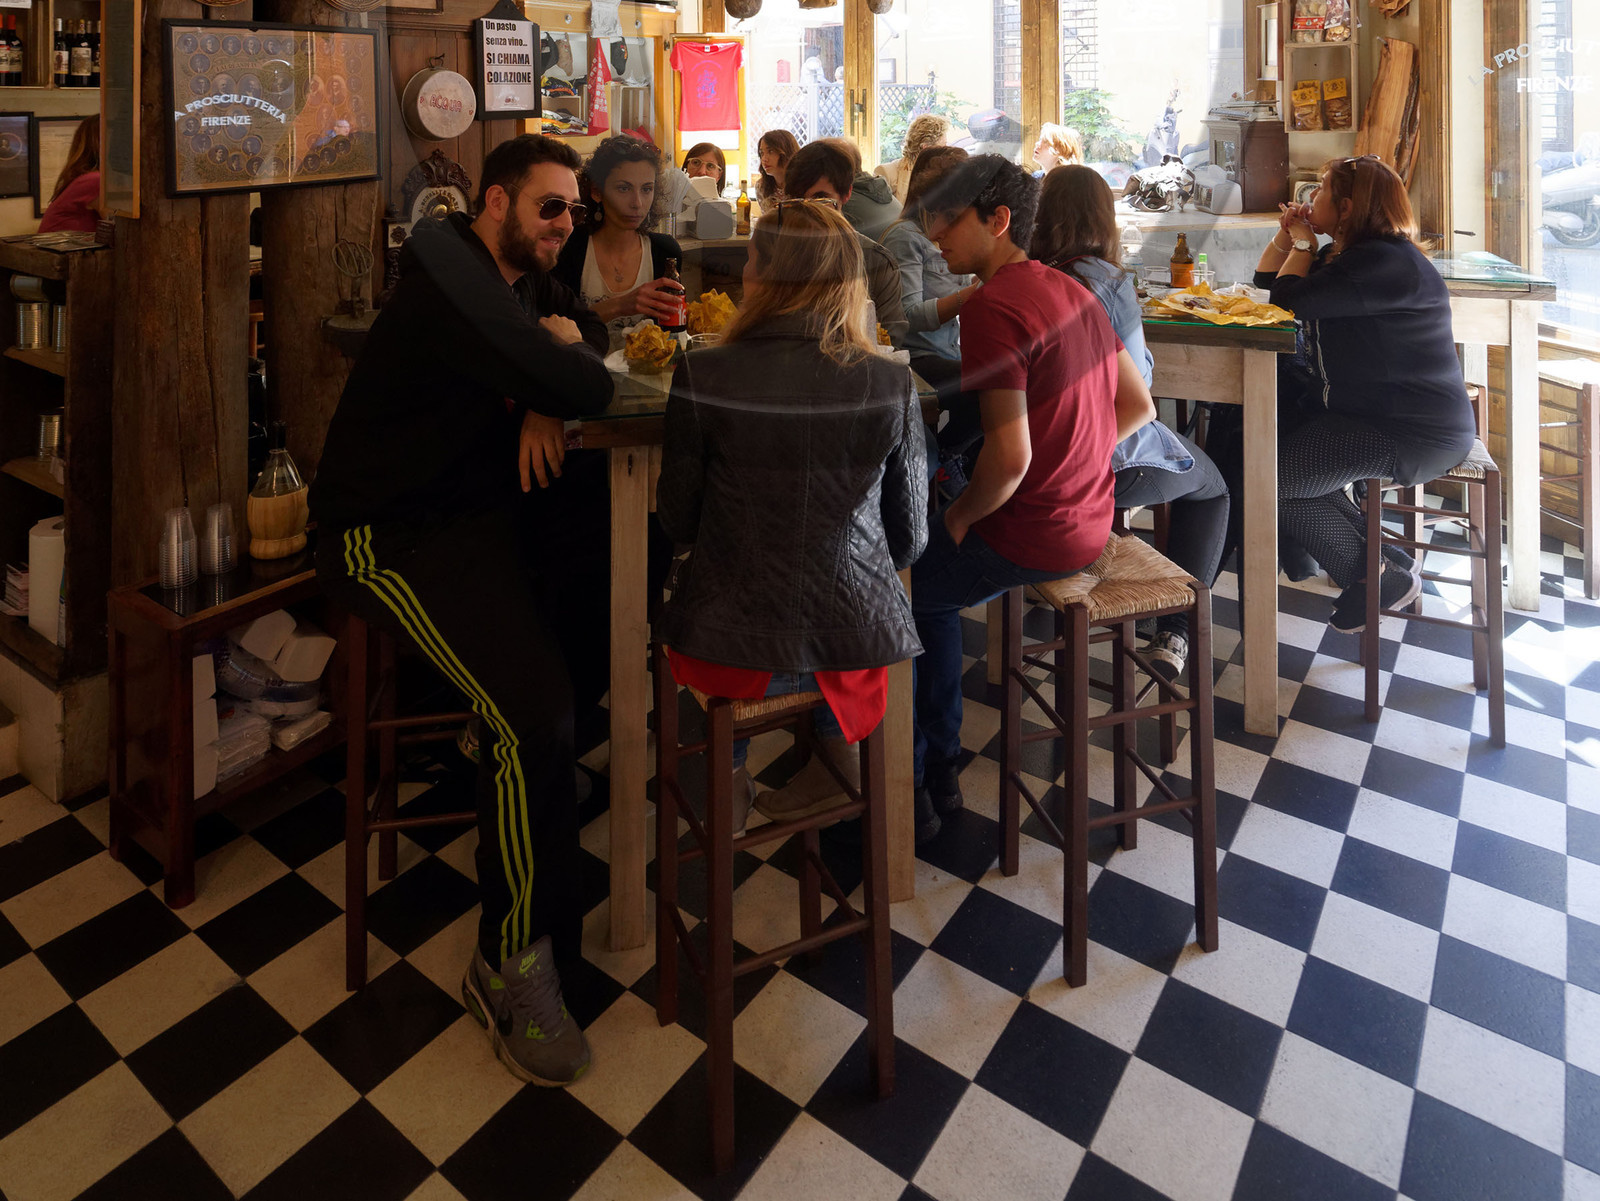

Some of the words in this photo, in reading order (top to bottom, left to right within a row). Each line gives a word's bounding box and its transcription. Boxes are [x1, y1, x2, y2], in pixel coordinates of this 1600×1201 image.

[485, 20, 495, 30] Un
[496, 21, 517, 31] pasto
[485, 36, 507, 46] senza
[486, 52, 496, 65] SI
[497, 52, 530, 65] CHIAMA
[486, 71, 532, 83] COLAZIONE
[1516, 75, 1595, 94] FIRENZE
[184, 93, 288, 125] PROSCIUTTERIA
[429, 94, 463, 113] ACQUA
[201, 115, 253, 127] FIRENZE
